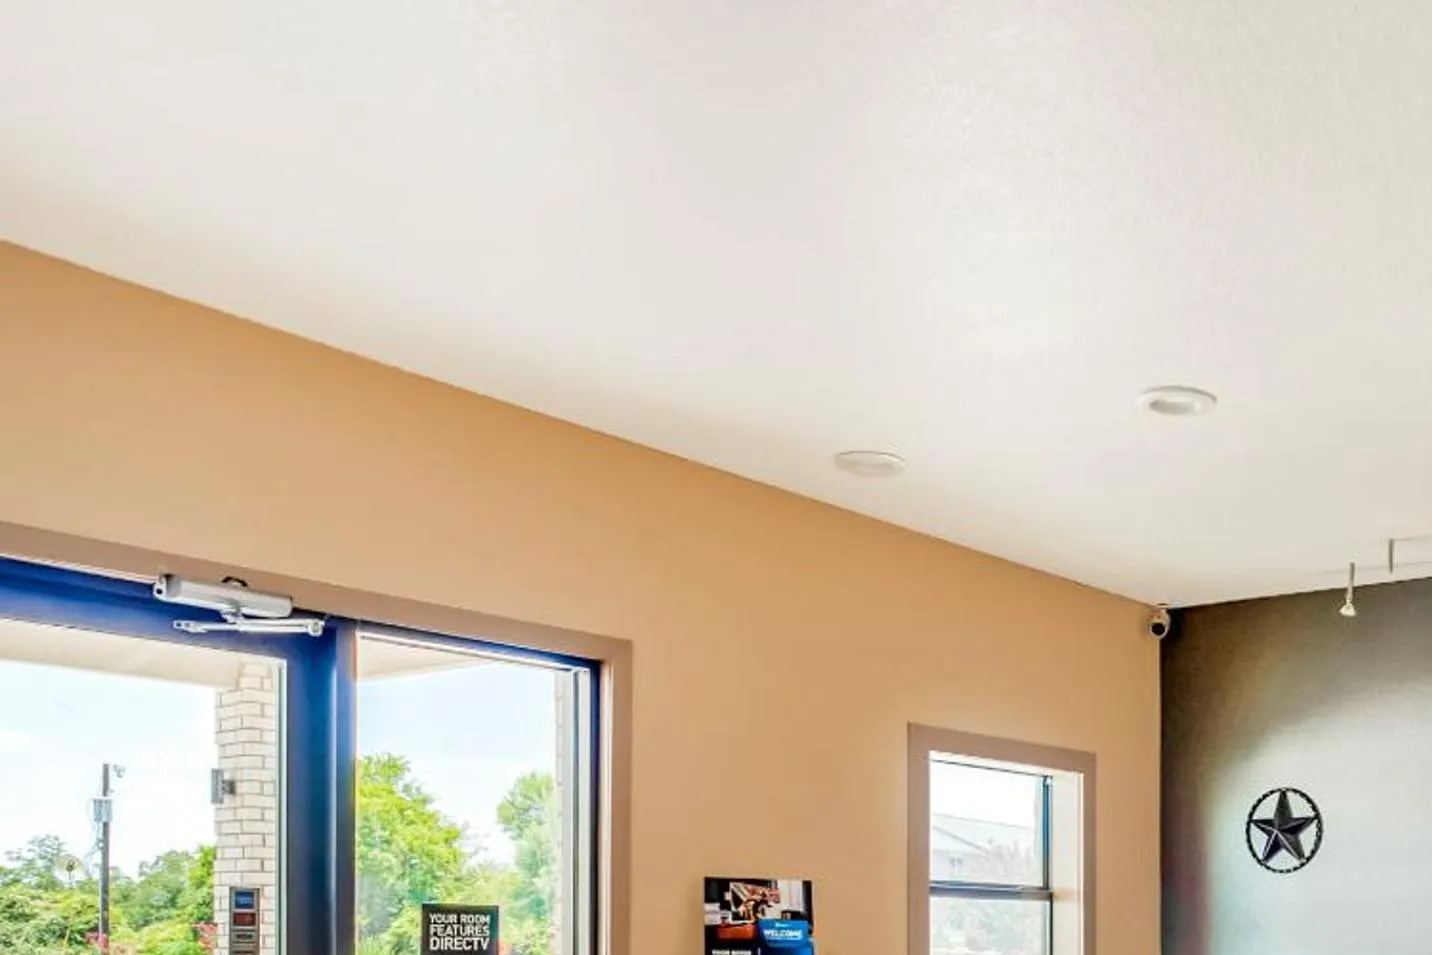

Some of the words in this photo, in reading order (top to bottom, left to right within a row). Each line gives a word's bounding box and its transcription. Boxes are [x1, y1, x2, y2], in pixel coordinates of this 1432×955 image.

[429, 913, 457, 924] YOUR
[460, 914, 491, 924] ROOM
[429, 924, 490, 937] FEATURES
[429, 936, 490, 951] DIRECTV
